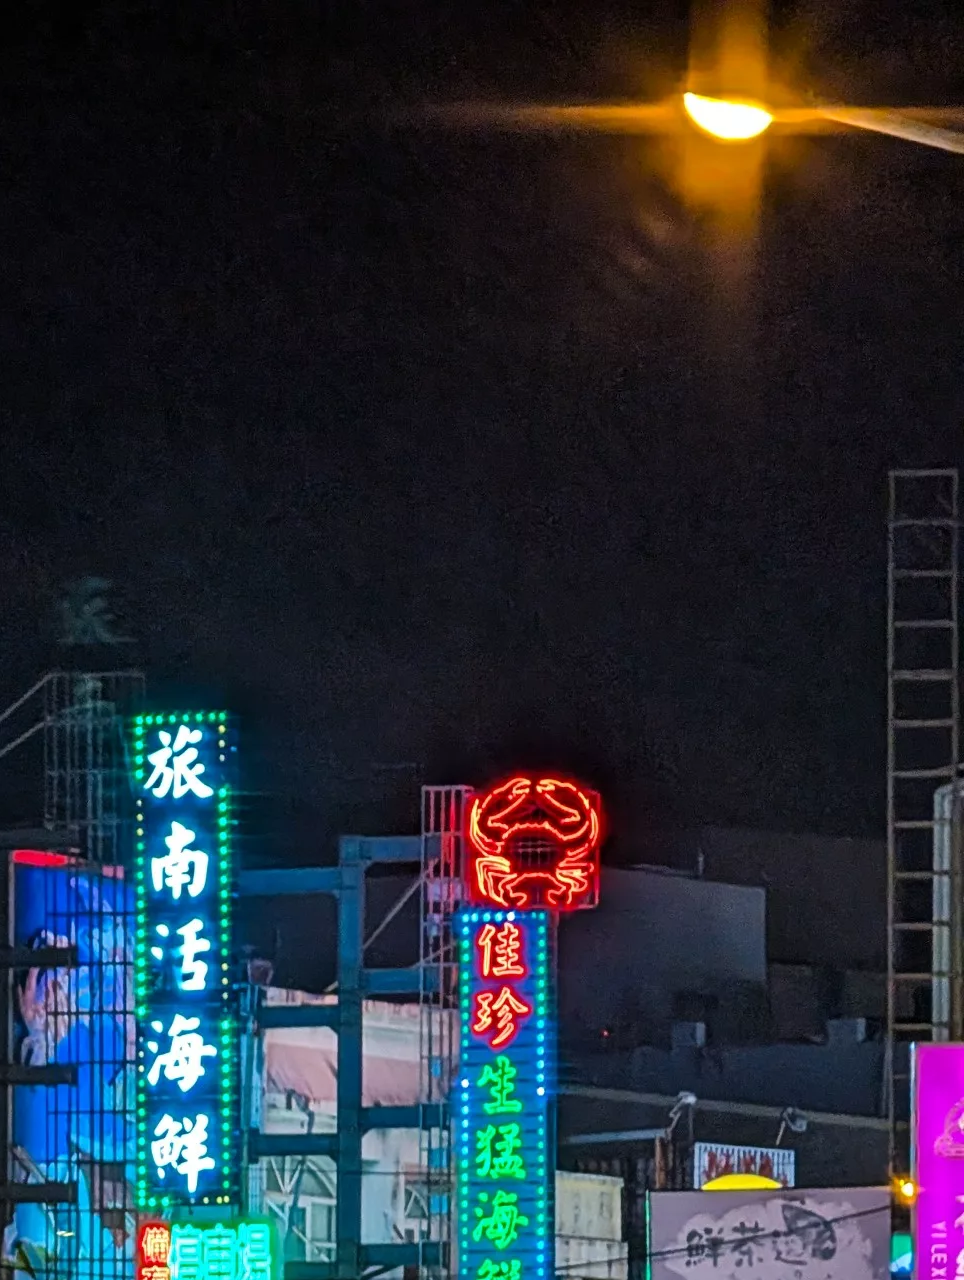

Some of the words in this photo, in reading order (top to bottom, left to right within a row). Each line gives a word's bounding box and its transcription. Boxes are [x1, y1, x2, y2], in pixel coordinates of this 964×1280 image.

[143, 725, 217, 1192] 旅南活海鮮
